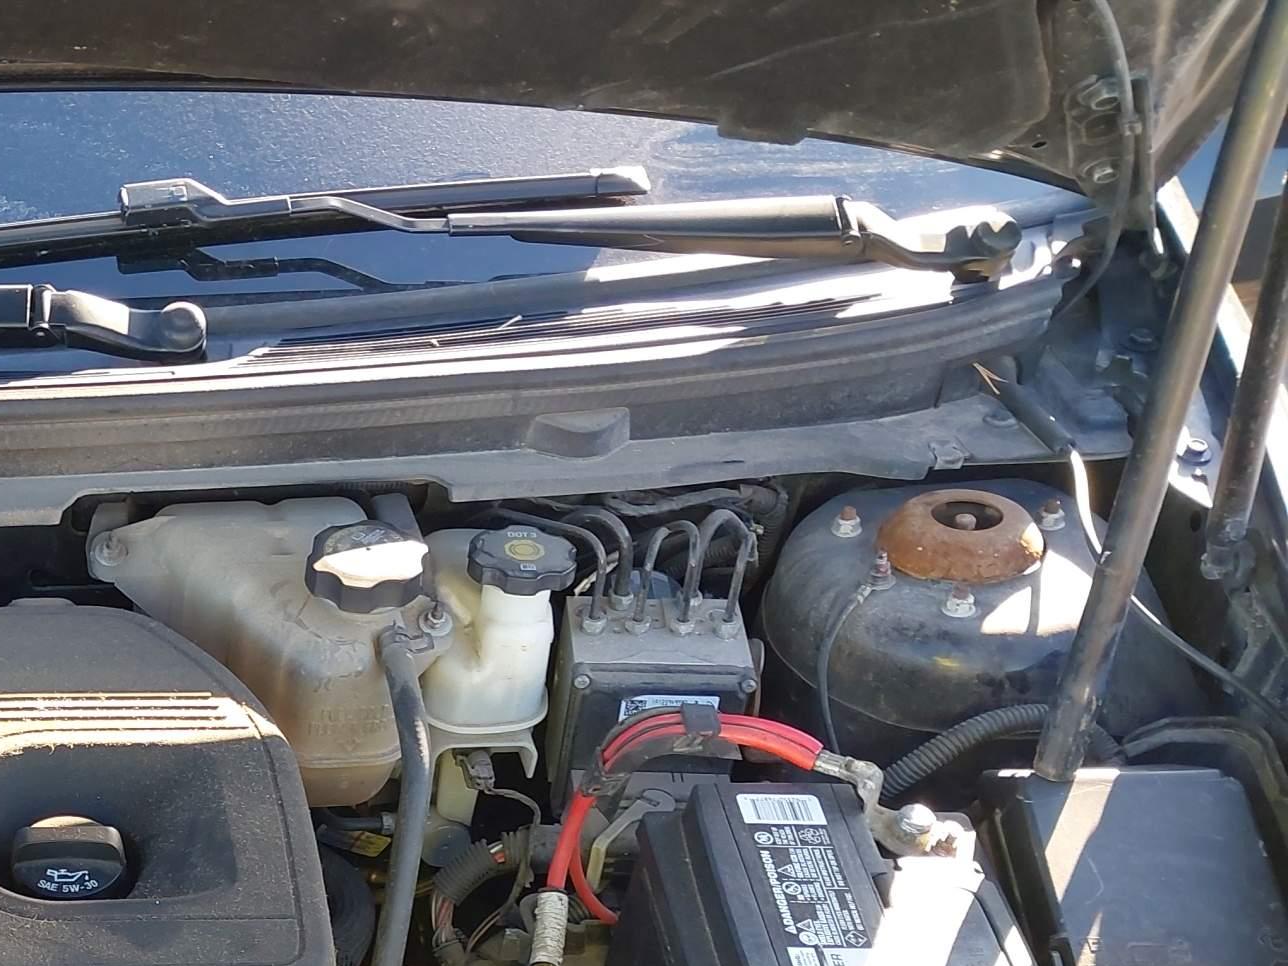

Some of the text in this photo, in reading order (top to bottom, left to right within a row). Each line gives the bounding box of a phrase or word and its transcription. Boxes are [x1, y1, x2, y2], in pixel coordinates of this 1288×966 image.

[37, 879, 98, 892] SAE 5W-30
[760, 850, 796, 928] DANGER/POISON
